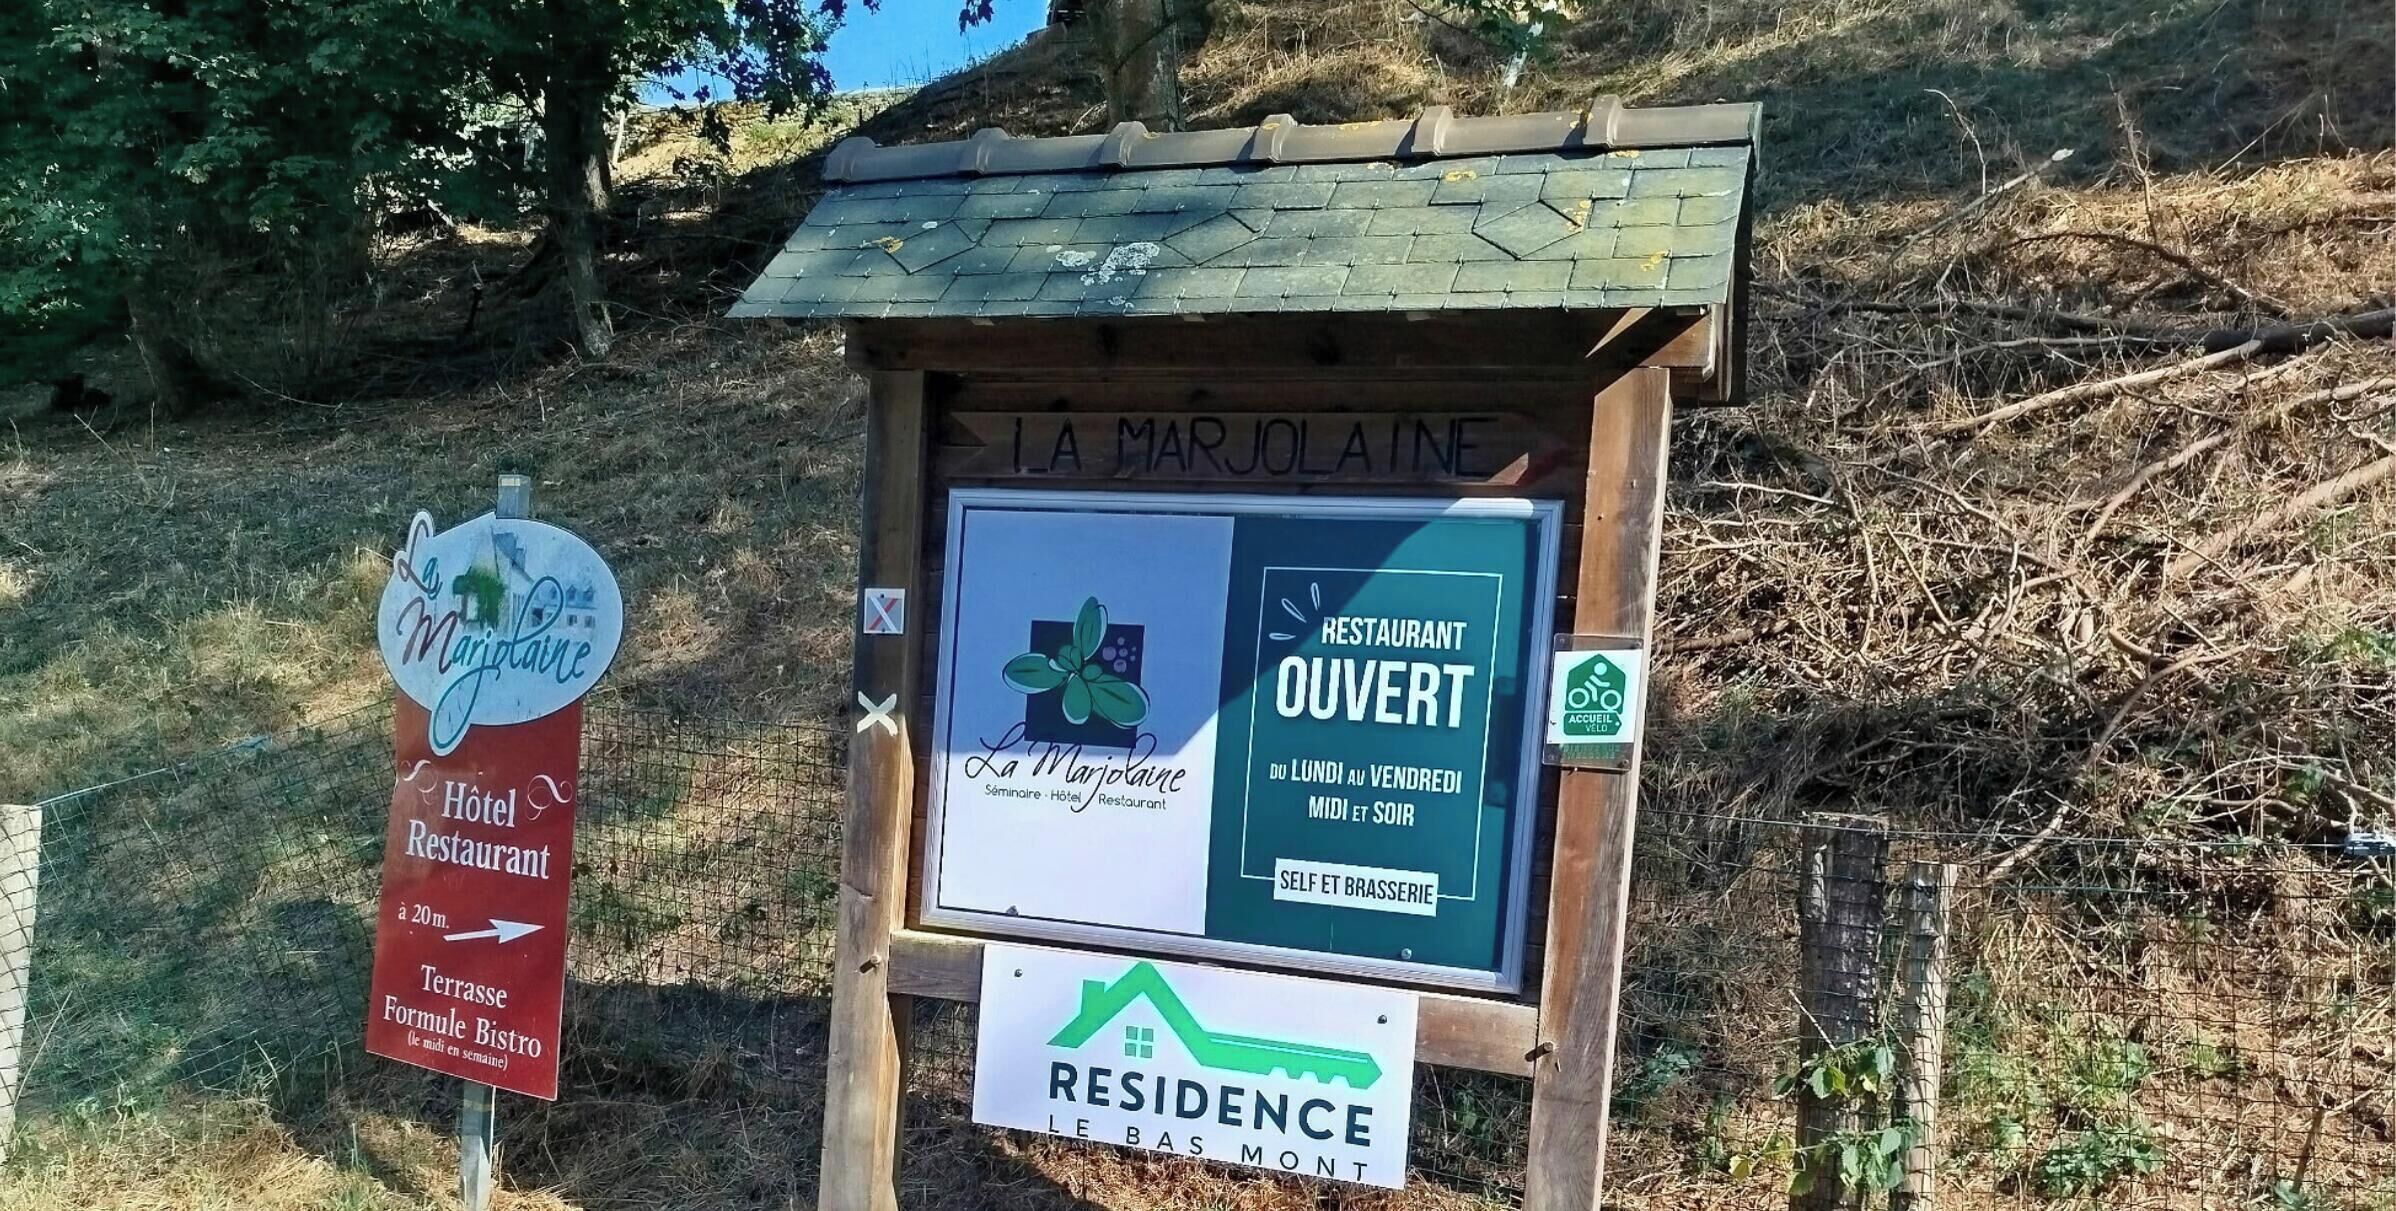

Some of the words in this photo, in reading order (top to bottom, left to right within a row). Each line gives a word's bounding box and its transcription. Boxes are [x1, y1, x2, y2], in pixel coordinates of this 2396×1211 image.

[1013, 416, 1082, 474] LA
[1118, 415, 1498, 477] MARJOLAINE
[397, 519, 443, 600] La
[1321, 616, 1467, 650] RESTAURANT
[396, 575, 592, 750] Marjolaine
[1275, 655, 1475, 729] OUVERT
[1568, 714, 1613, 724] ACCUEIL
[964, 721, 1026, 779] La
[1027, 732, 1187, 813] Marjolaine
[1269, 762, 1287, 780] DU
[1290, 758, 1343, 785] LUNDI
[1347, 769, 1365, 786] AU
[1370, 764, 1463, 794] VENDREDI
[441, 781, 517, 828] Hôtel
[984, 784, 1041, 800] Séminaire
[1050, 789, 1082, 804] Hôtel
[1098, 793, 1167, 810] Restaurant
[1308, 795, 1348, 821] MIDI
[1352, 805, 1368, 822] ET
[1372, 801, 1416, 826] SOIR
[405, 819, 551, 880] Restaurant
[398, 901, 406, 921] à
[1280, 870, 1318, 893] SELF
[1321, 875, 1341, 896] ET
[1344, 877, 1435, 906] BRASSERIE
[420, 964, 508, 1009] Terrasse
[383, 994, 467, 1040] Formule
[475, 1017, 542, 1058] Bistro
[422, 1036, 445, 1054] midi
[447, 1045, 460, 1057] en
[462, 1048, 509, 1072] semaine)
[1049, 1061, 1374, 1146] RESIDENCE
[1049, 1114, 1090, 1138] LE
[1126, 1126, 1203, 1155] BAS
[1241, 1144, 1368, 1182] MONT
